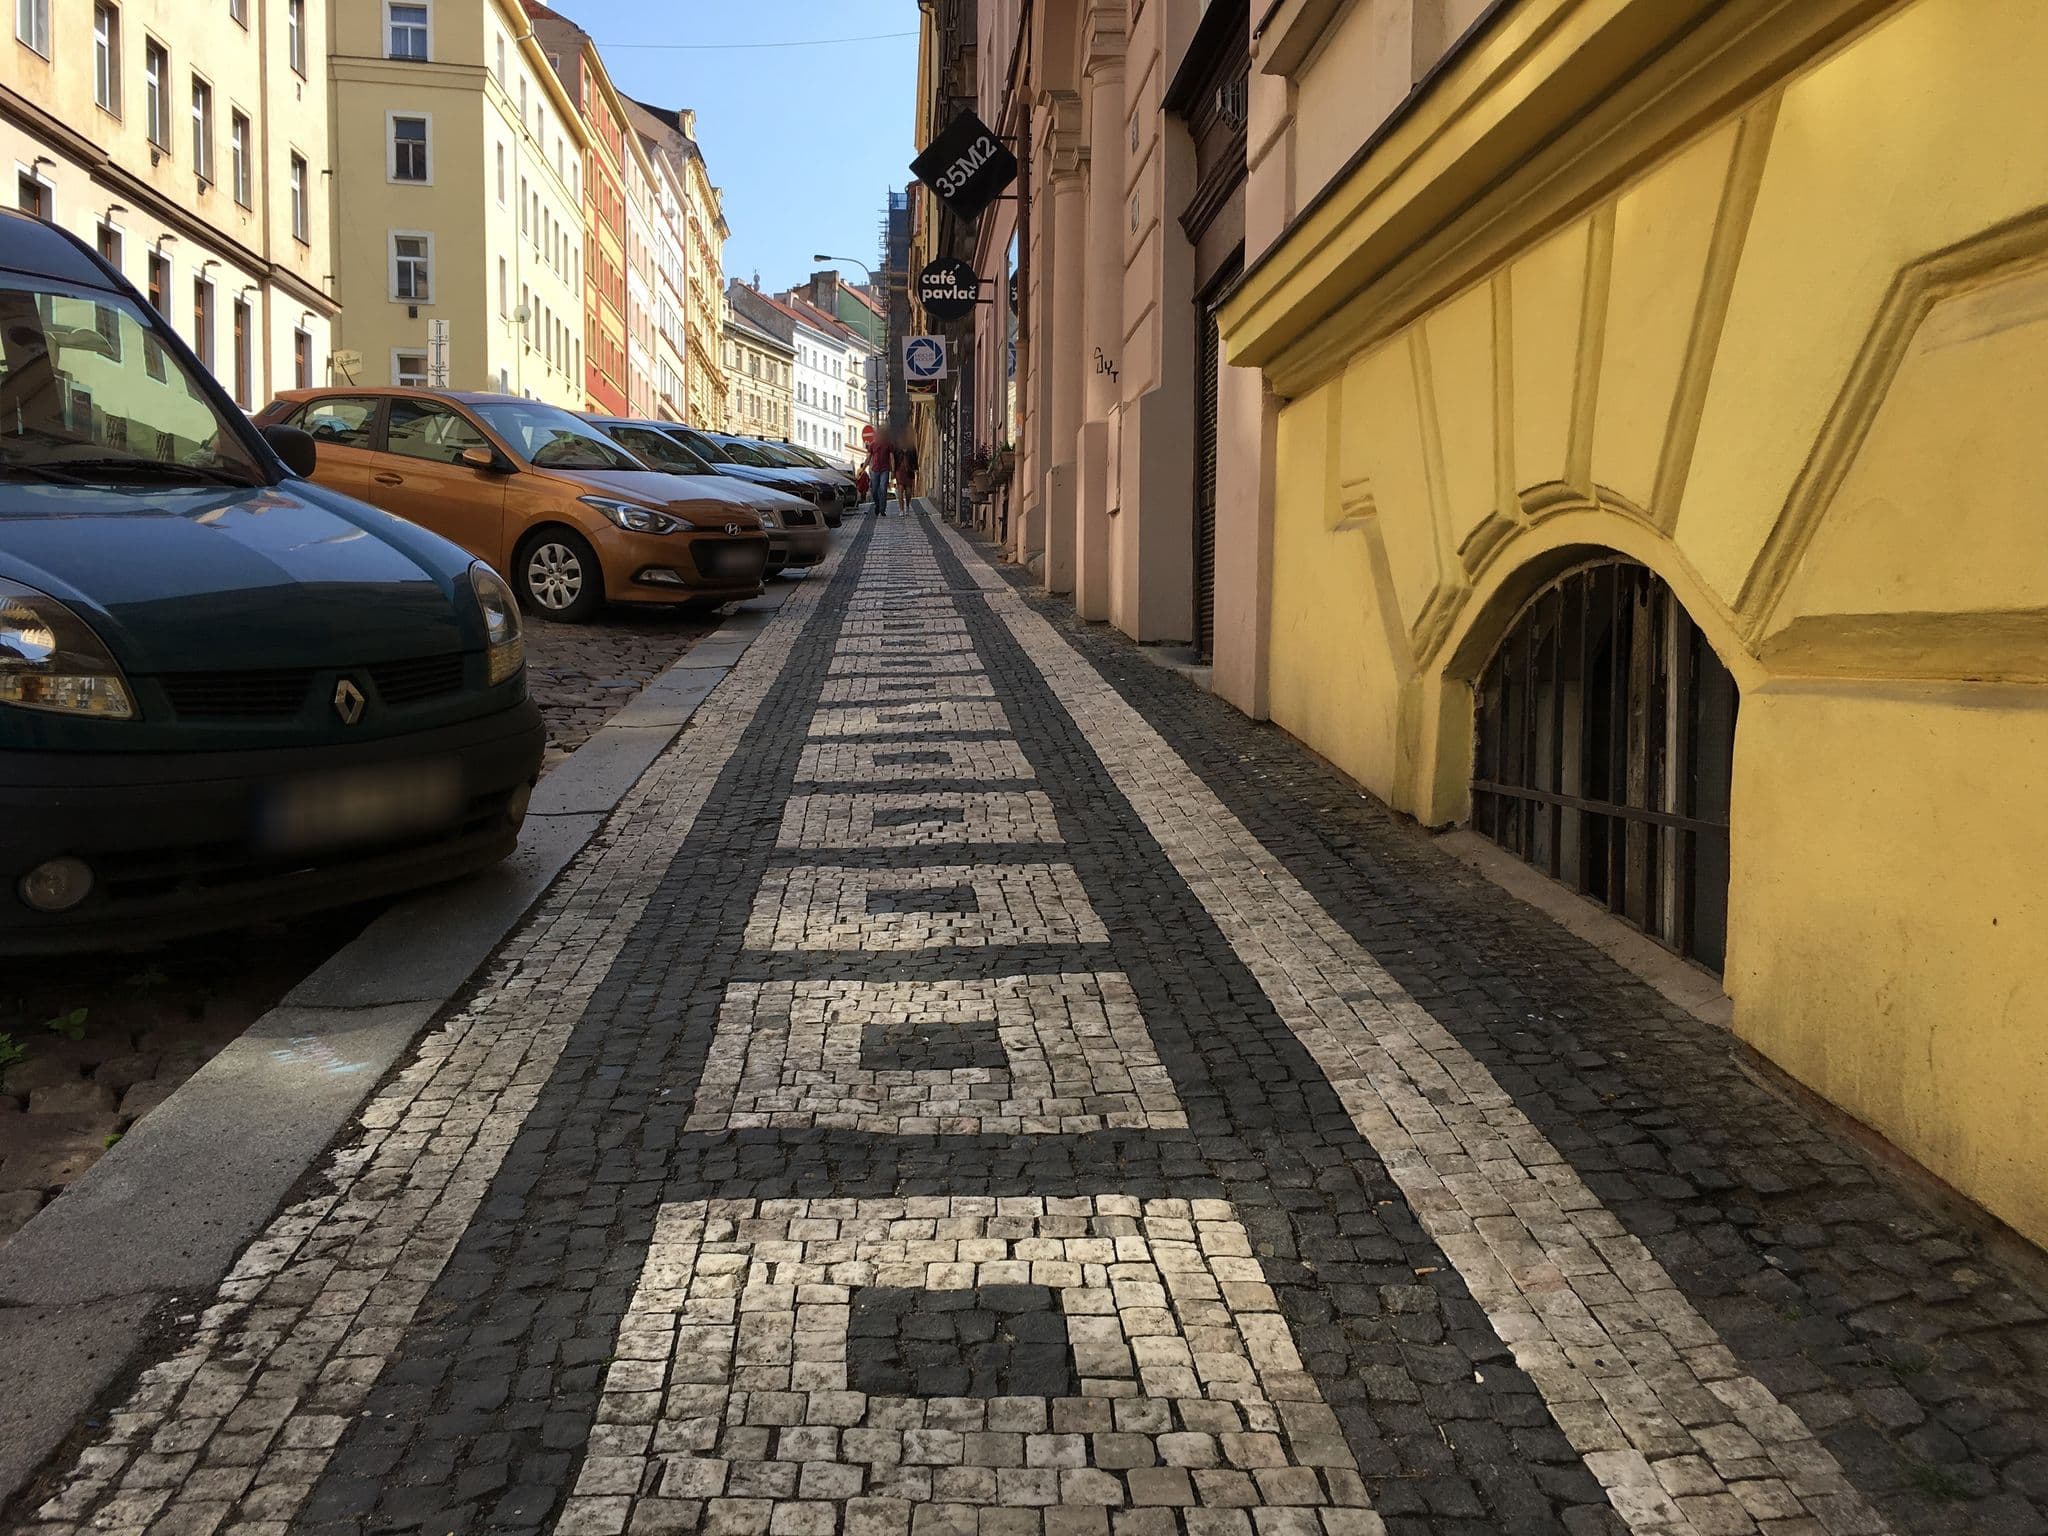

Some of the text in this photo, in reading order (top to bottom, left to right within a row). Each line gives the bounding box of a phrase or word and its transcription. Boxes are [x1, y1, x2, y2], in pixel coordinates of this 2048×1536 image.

[936, 136, 998, 198] 35M2
[922, 270, 956, 285] café
[922, 285, 976, 303] pavlač
